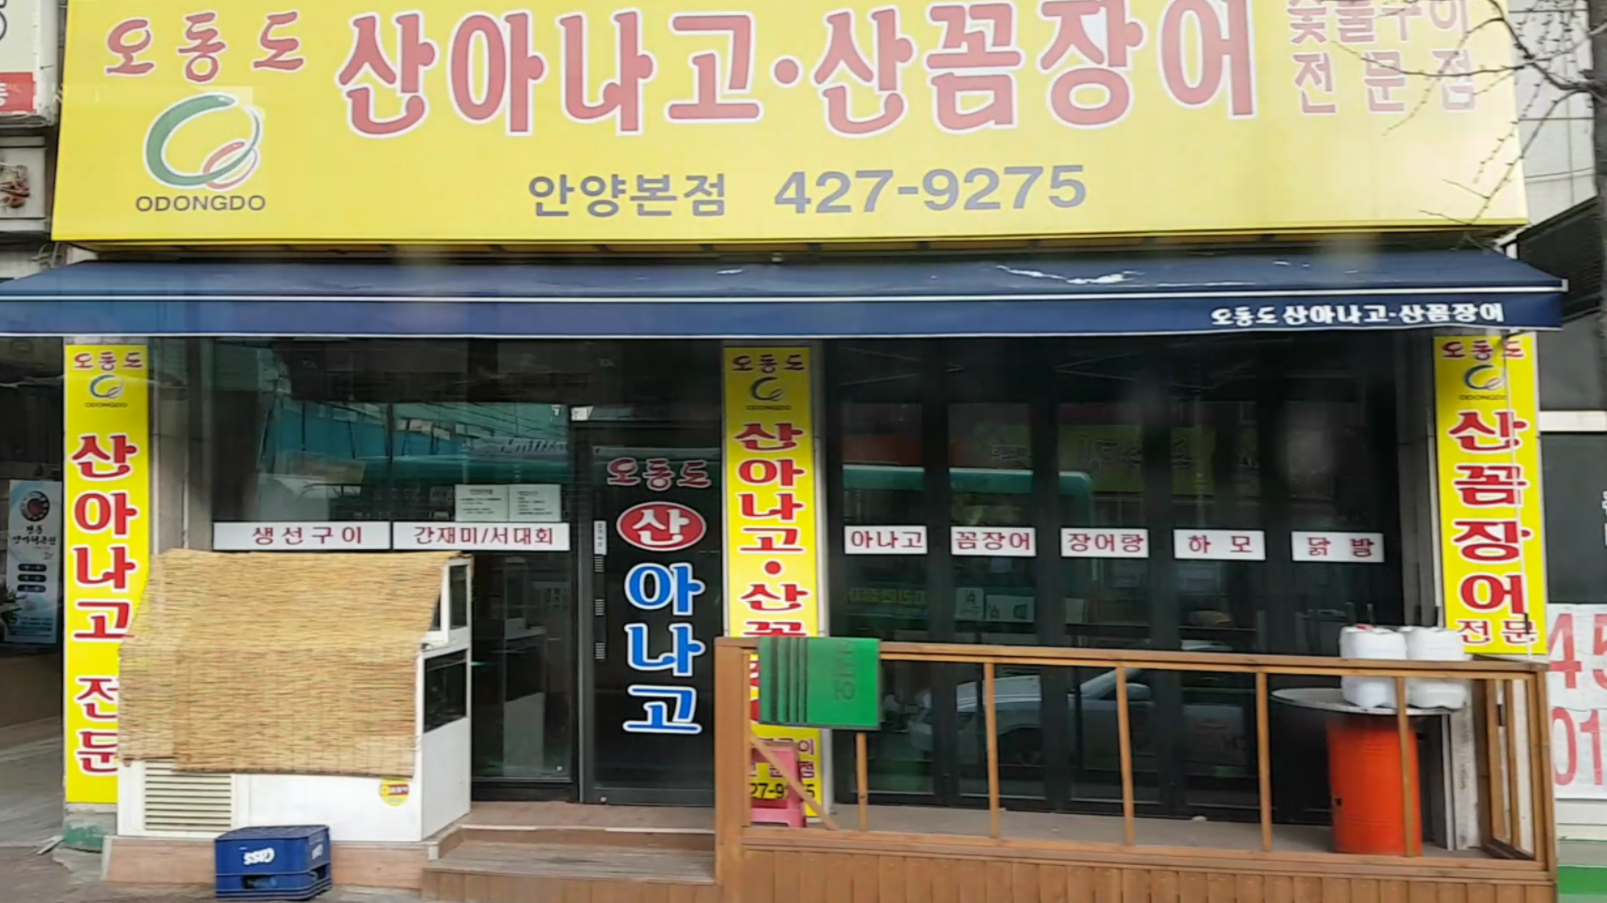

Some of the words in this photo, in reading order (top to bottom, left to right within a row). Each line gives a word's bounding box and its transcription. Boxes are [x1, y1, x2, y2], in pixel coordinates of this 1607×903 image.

[106, 11, 305, 82] 오동도
[527, 174, 727, 217] 안양본점
[774, 165, 1086, 214] 427-9275
[135, 195, 267, 212] ODONGDO
[1211, 306, 1277, 326] 오동도
[73, 351, 144, 371] 오동도
[1441, 340, 1525, 361] 오동도
[732, 353, 806, 374] 오동도
[607, 456, 713, 491] 오동도
[251, 525, 363, 546] 생선구이
[413, 526, 554, 546] 간재미/서대회
[850, 530, 924, 550] 아나고
[955, 531, 1031, 551] 꼼장어
[1066, 533, 1145, 553] 장어탕
[1455, 620, 1538, 645] 전문
